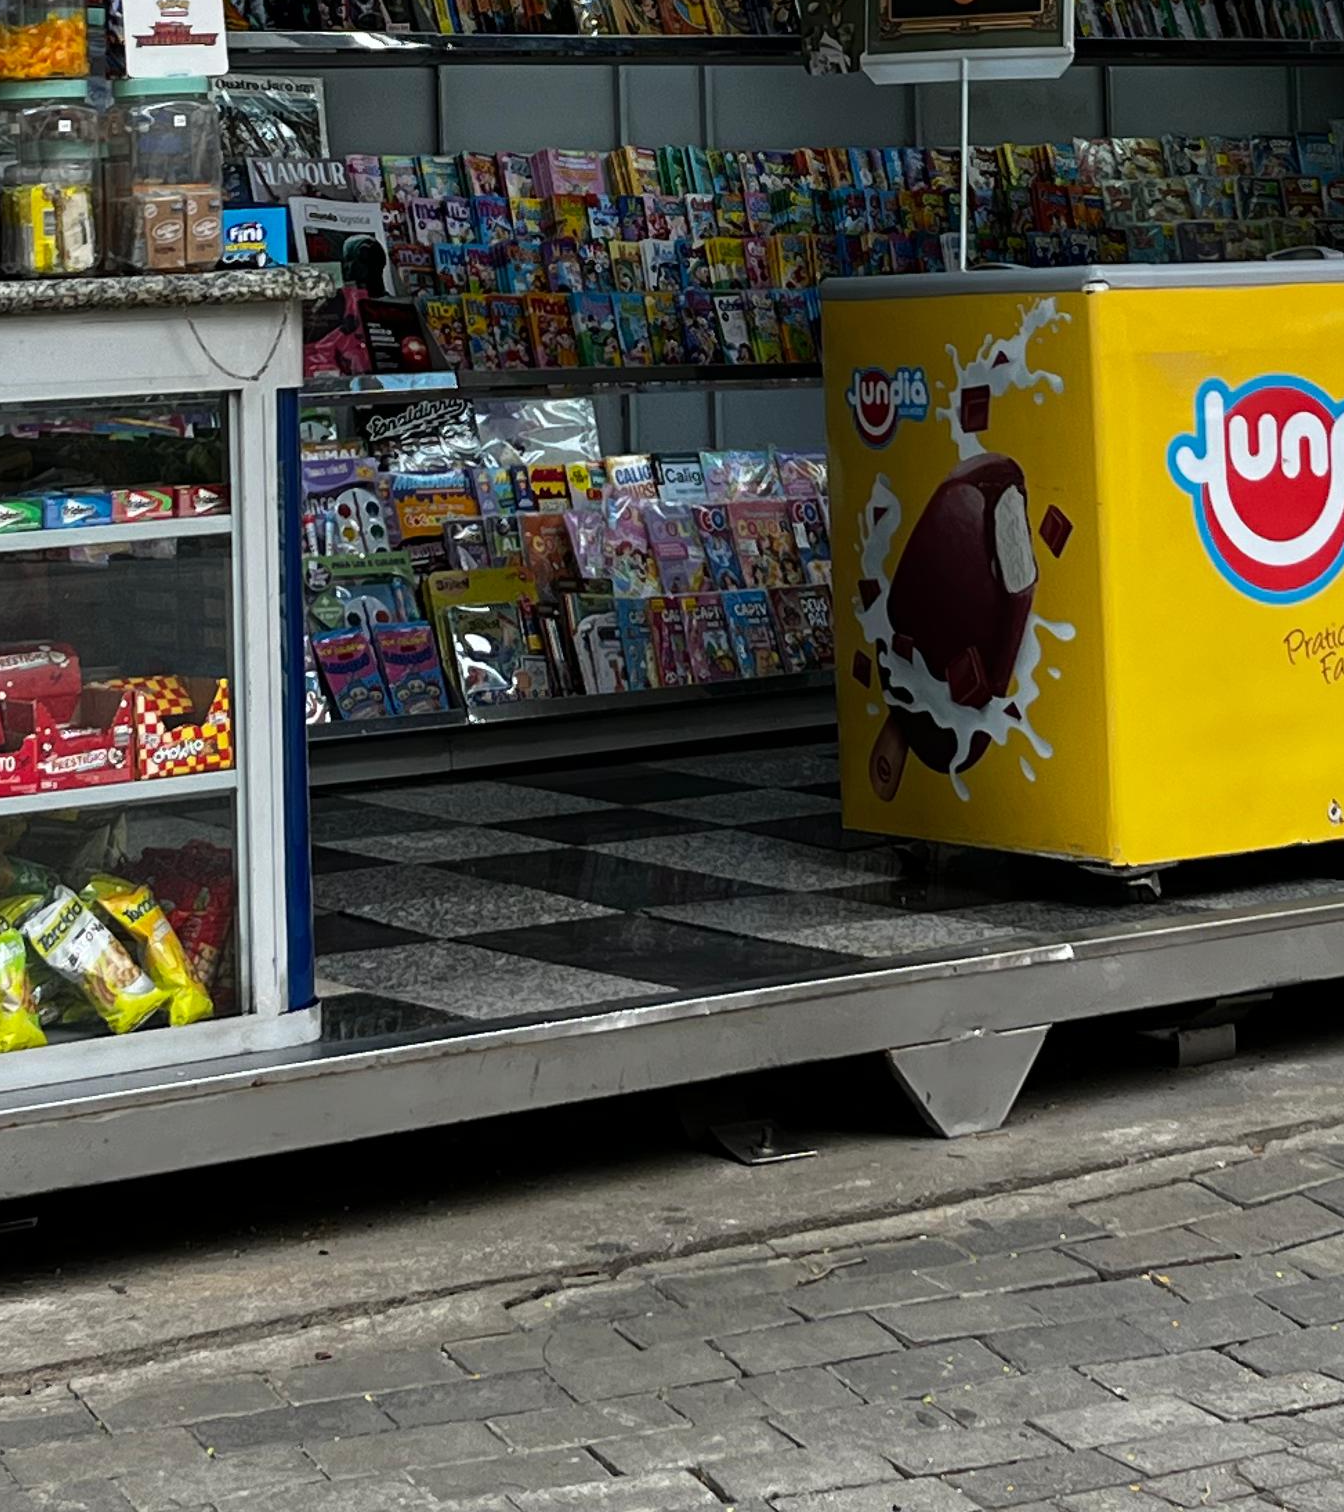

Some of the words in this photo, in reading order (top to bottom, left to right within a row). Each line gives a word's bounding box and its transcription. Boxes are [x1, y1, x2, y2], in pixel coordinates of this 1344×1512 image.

[255, 161, 347, 188] GLAMOUR
[229, 223, 263, 243] Fini
[851, 366, 929, 425] Jundiá
[37, 900, 84, 953] Torcido
